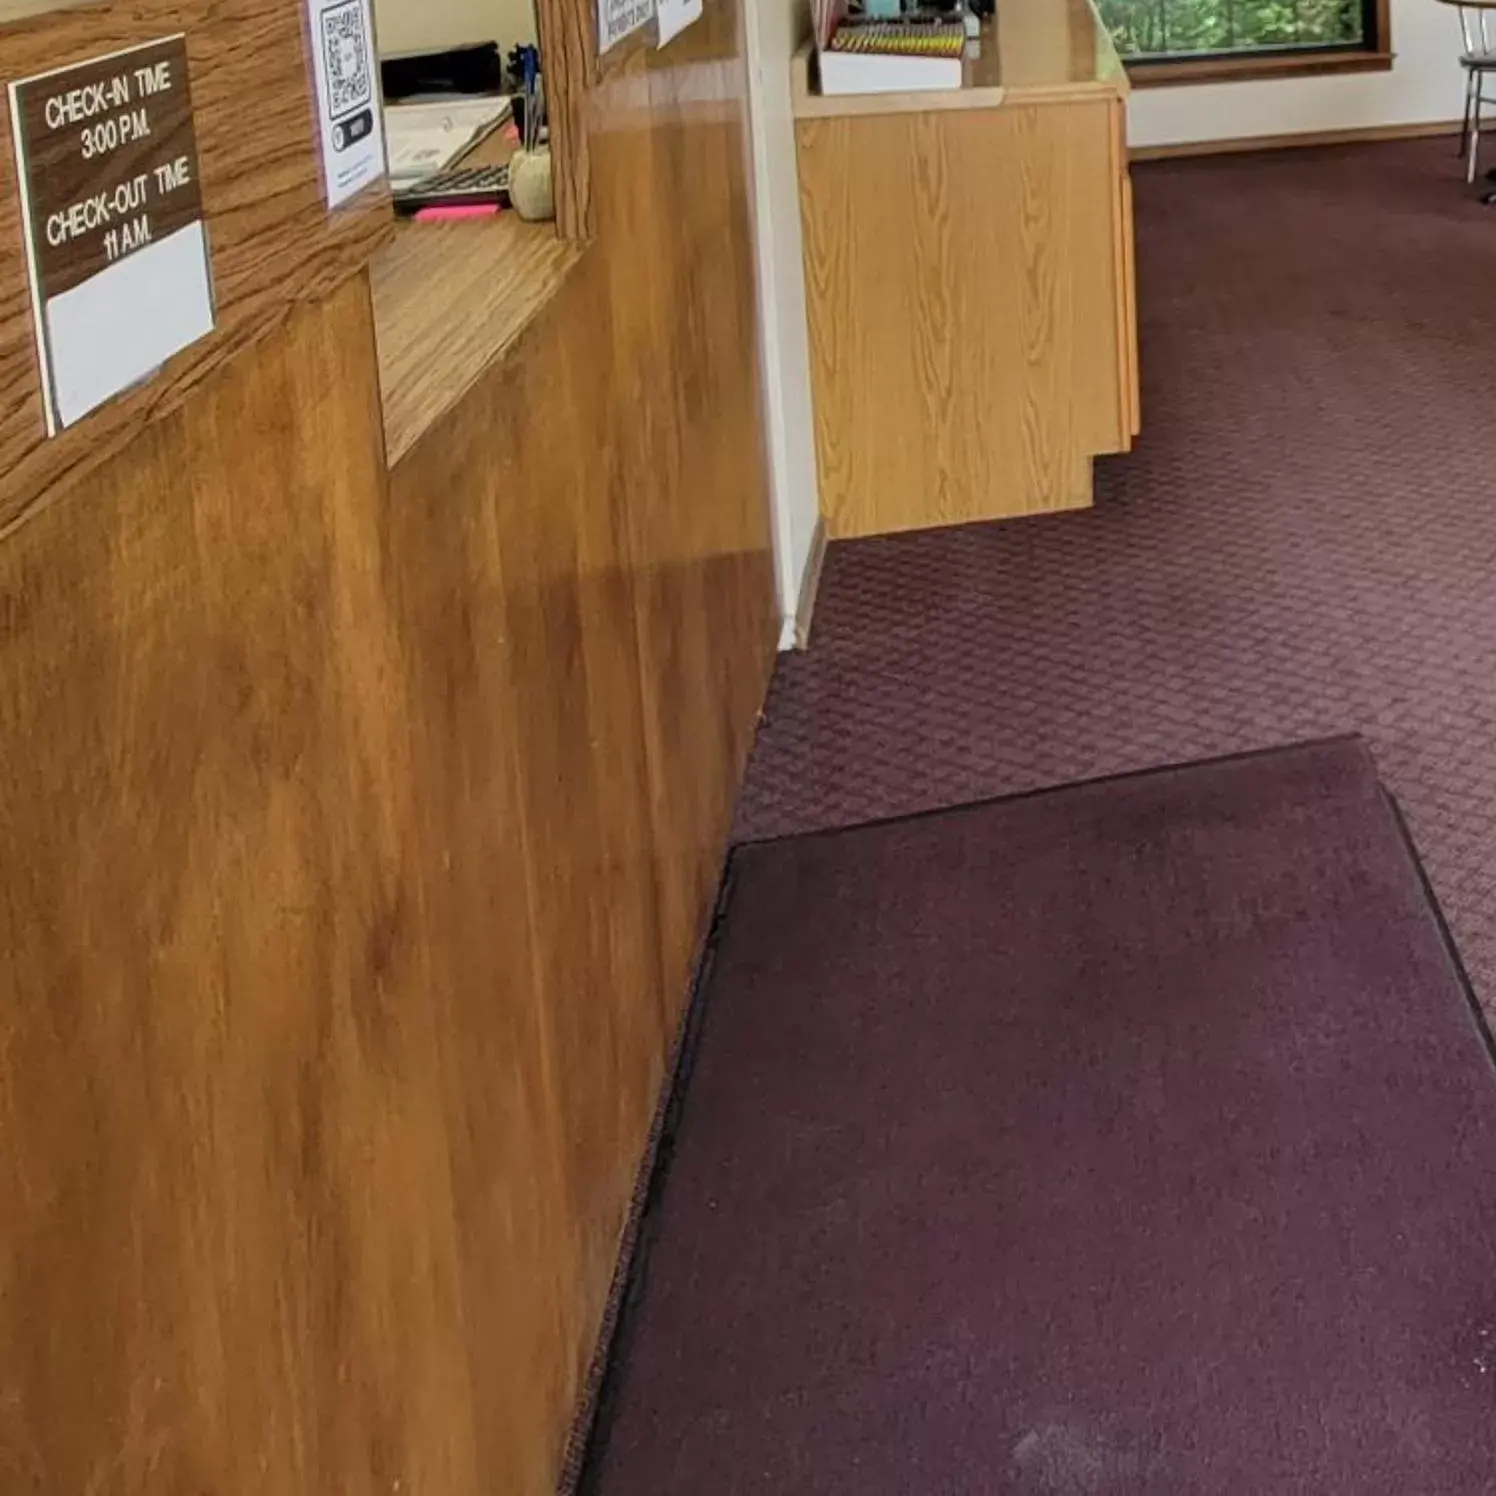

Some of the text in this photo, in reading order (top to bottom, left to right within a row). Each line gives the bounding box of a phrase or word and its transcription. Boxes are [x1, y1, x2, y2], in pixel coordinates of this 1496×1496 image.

[45, 61, 172, 129] CHECK-IN TIME
[80, 119, 117, 160] 3:00
[46, 155, 191, 246] CHECK-OUT TIME
[103, 228, 119, 261] 11
